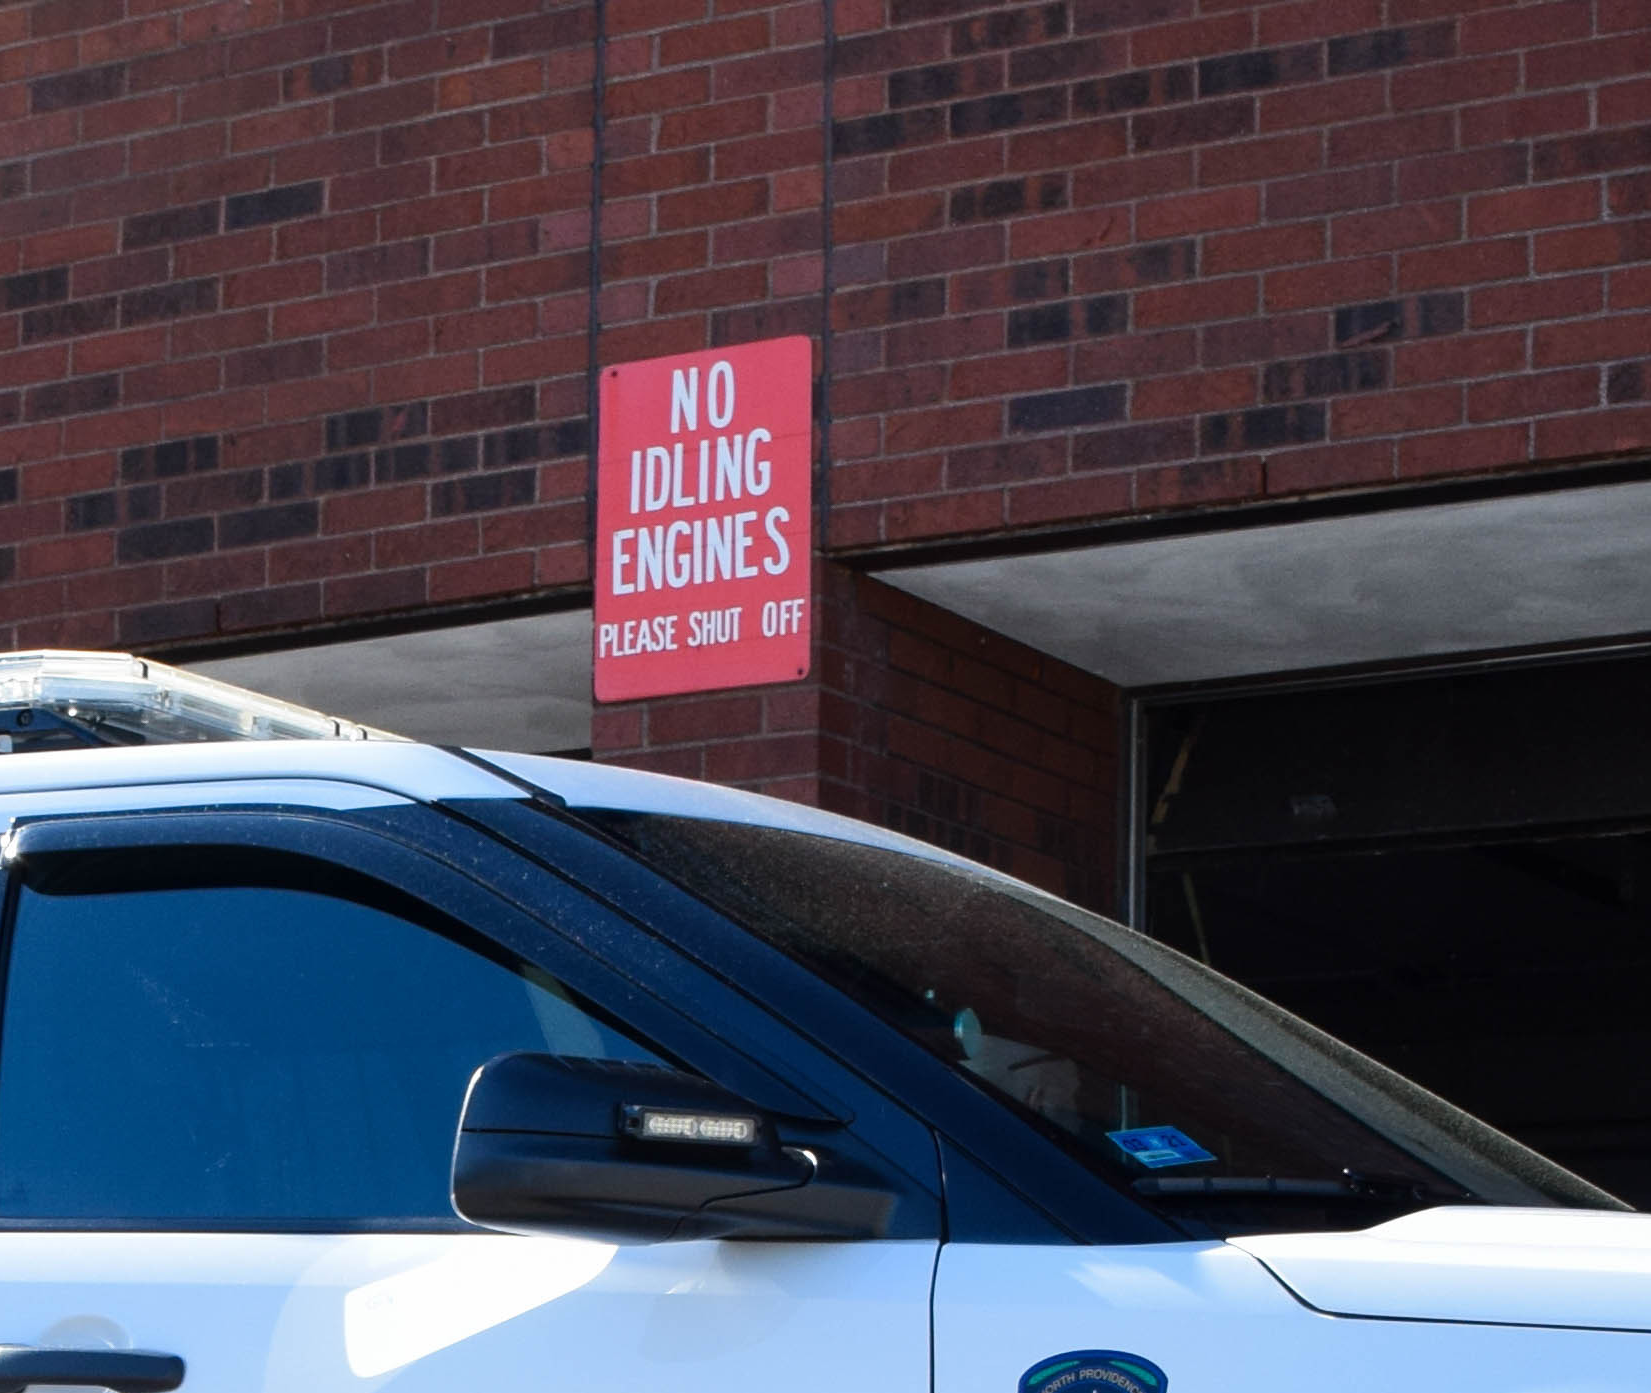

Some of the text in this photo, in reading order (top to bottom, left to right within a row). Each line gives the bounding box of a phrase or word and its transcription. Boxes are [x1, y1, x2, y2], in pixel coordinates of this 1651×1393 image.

[670, 360, 736, 434] NO
[630, 428, 772, 514] IDLING
[612, 506, 791, 596] ENGINES
[599, 599, 805, 658] PLEASE SHUT OFF
